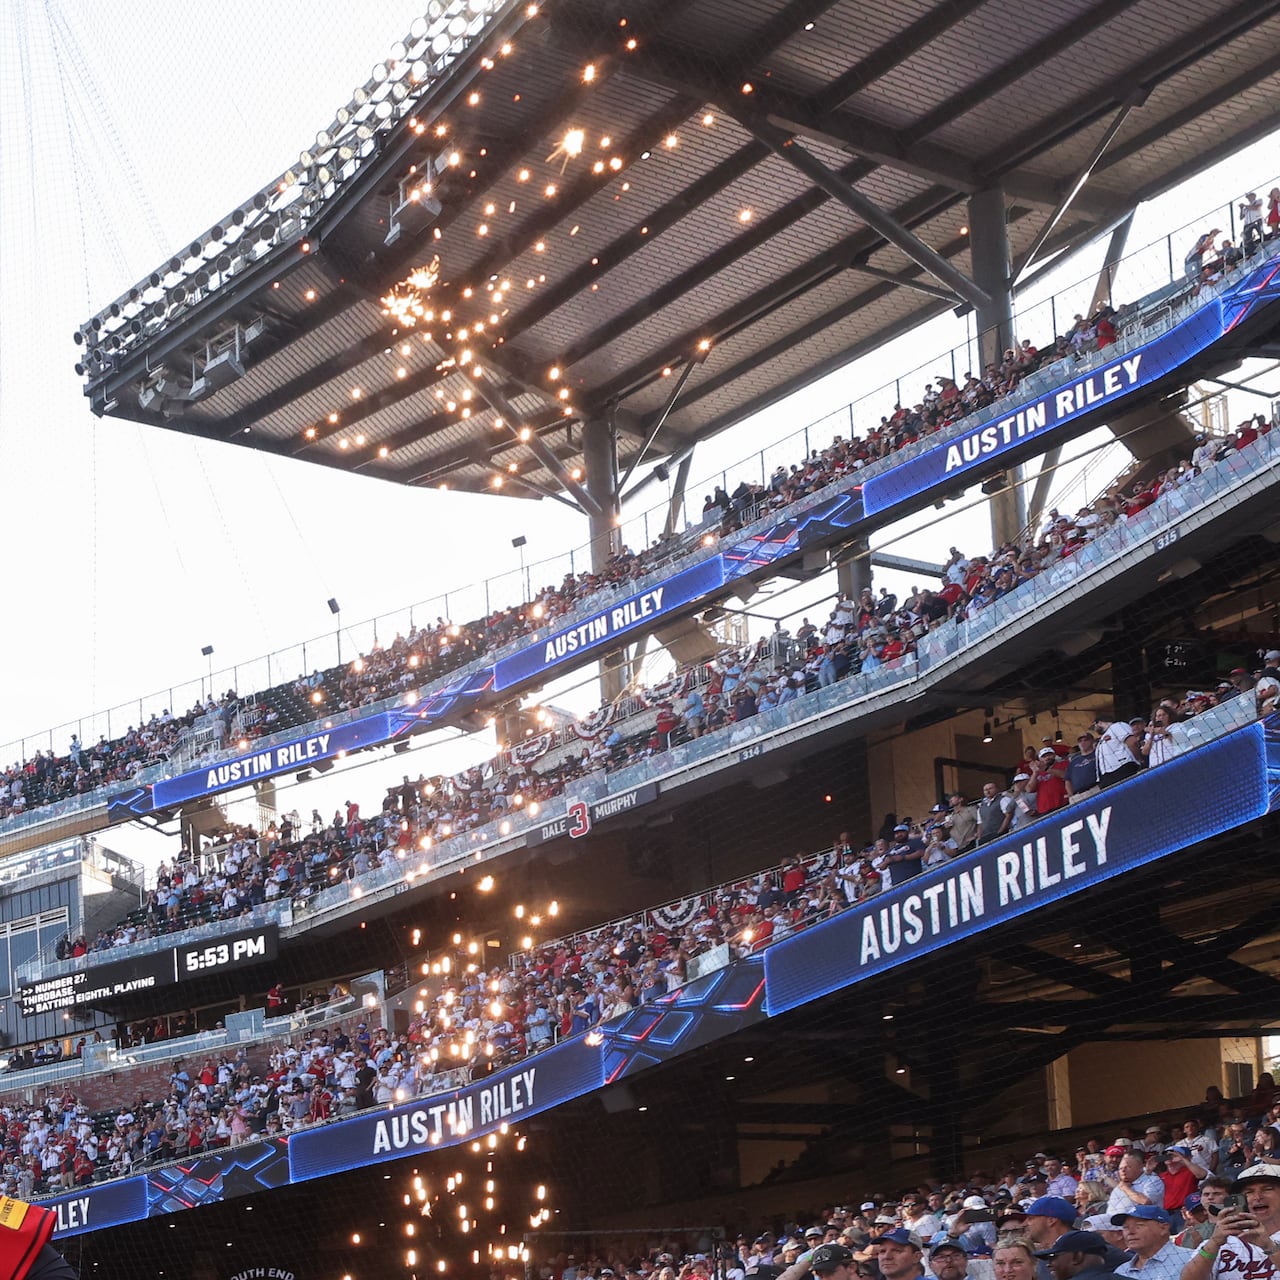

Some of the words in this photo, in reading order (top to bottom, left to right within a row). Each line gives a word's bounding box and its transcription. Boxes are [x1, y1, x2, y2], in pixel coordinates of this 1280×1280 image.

[944, 401, 1046, 473] AUSTIN
[1055, 354, 1143, 419] RILEY
[1156, 529, 1177, 551] 315
[544, 615, 608, 664] AUSTIN
[611, 587, 664, 631] RILEY
[206, 752, 272, 789] AUSTIN
[276, 733, 330, 768] RILEY
[742, 746, 761, 760] 314
[541, 820, 568, 840] DALE
[567, 801, 590, 839] 3
[594, 792, 638, 819] MURPHY
[859, 865, 985, 967] AUSTIN
[996, 805, 1113, 907] RILEY
[186, 943, 230, 972] 5:53
[233, 935, 266, 961] PM
[35, 977, 74, 994] NUMBER
[74, 973, 88, 986] 27.
[35, 995, 75, 1013] BATTING
[76, 988, 114, 1005] EIGHTH.
[114, 976, 156, 994] PLAYING
[373, 1095, 474, 1155] AUSTIN
[480, 1067, 537, 1126] RILEY
